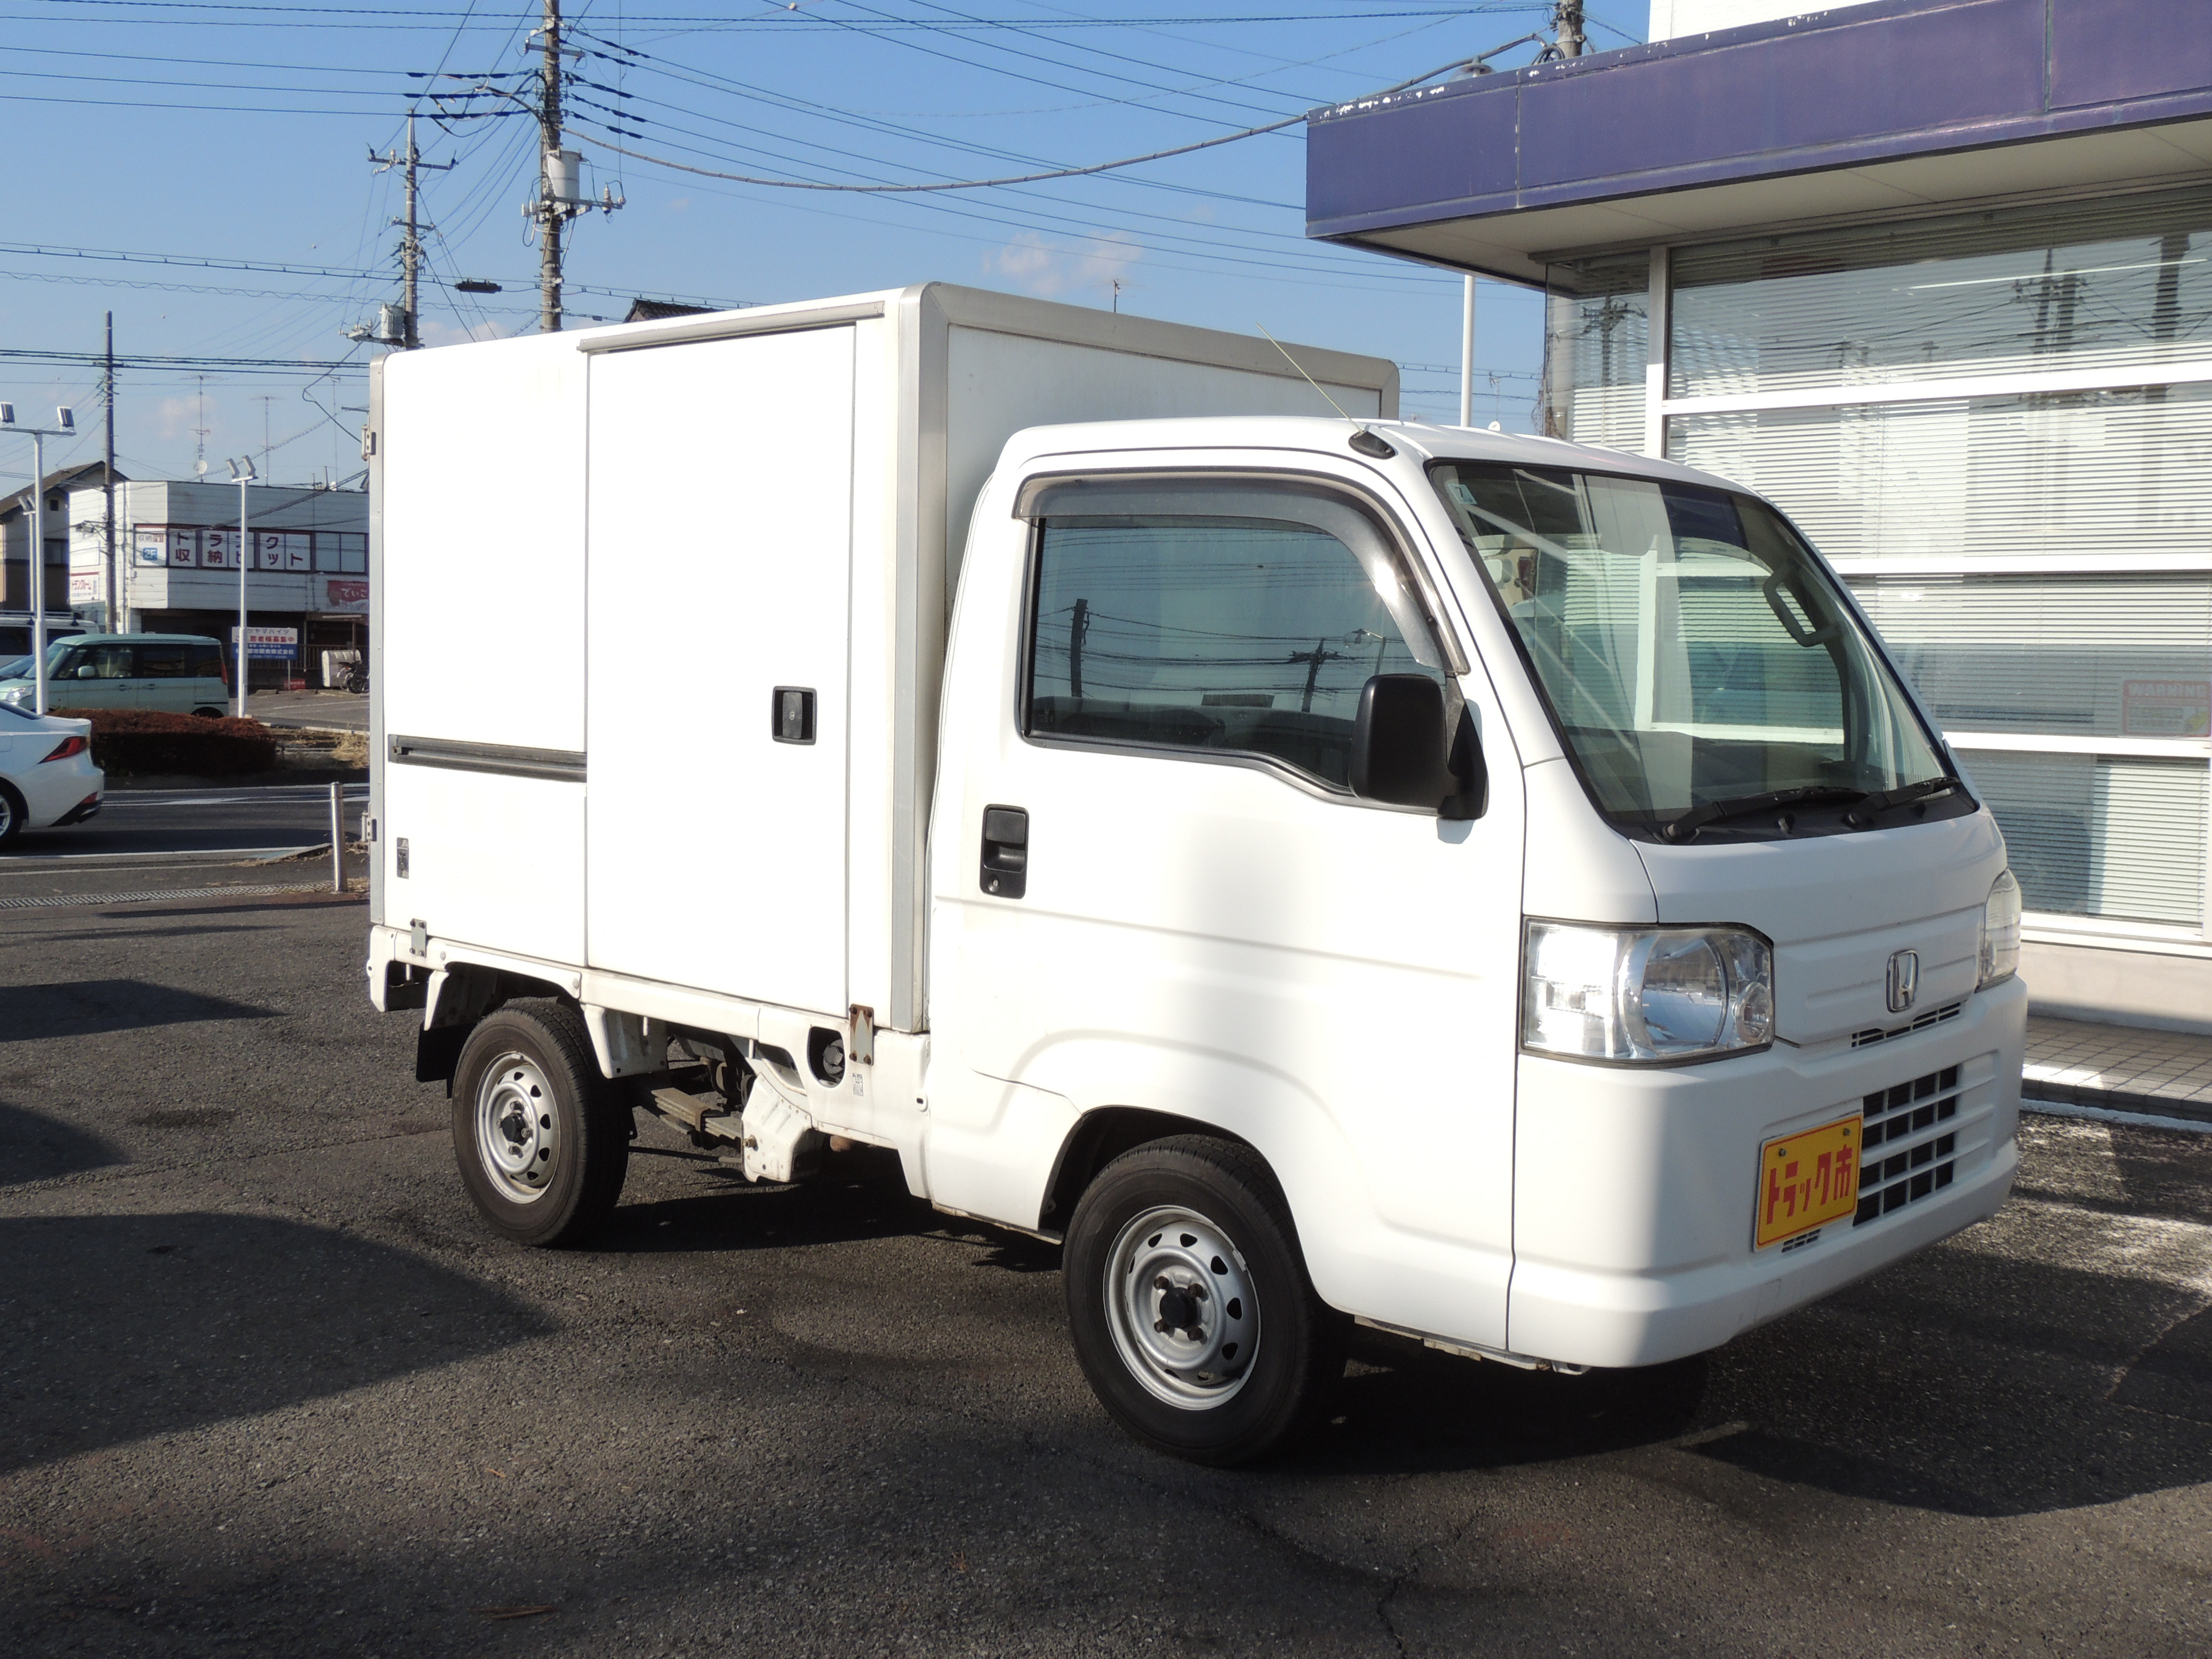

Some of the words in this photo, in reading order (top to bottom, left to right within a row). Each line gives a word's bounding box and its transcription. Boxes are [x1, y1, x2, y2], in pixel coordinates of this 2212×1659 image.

[2129, 684, 2207, 697] WARNING
[1766, 1144, 1853, 1225] トラック市
